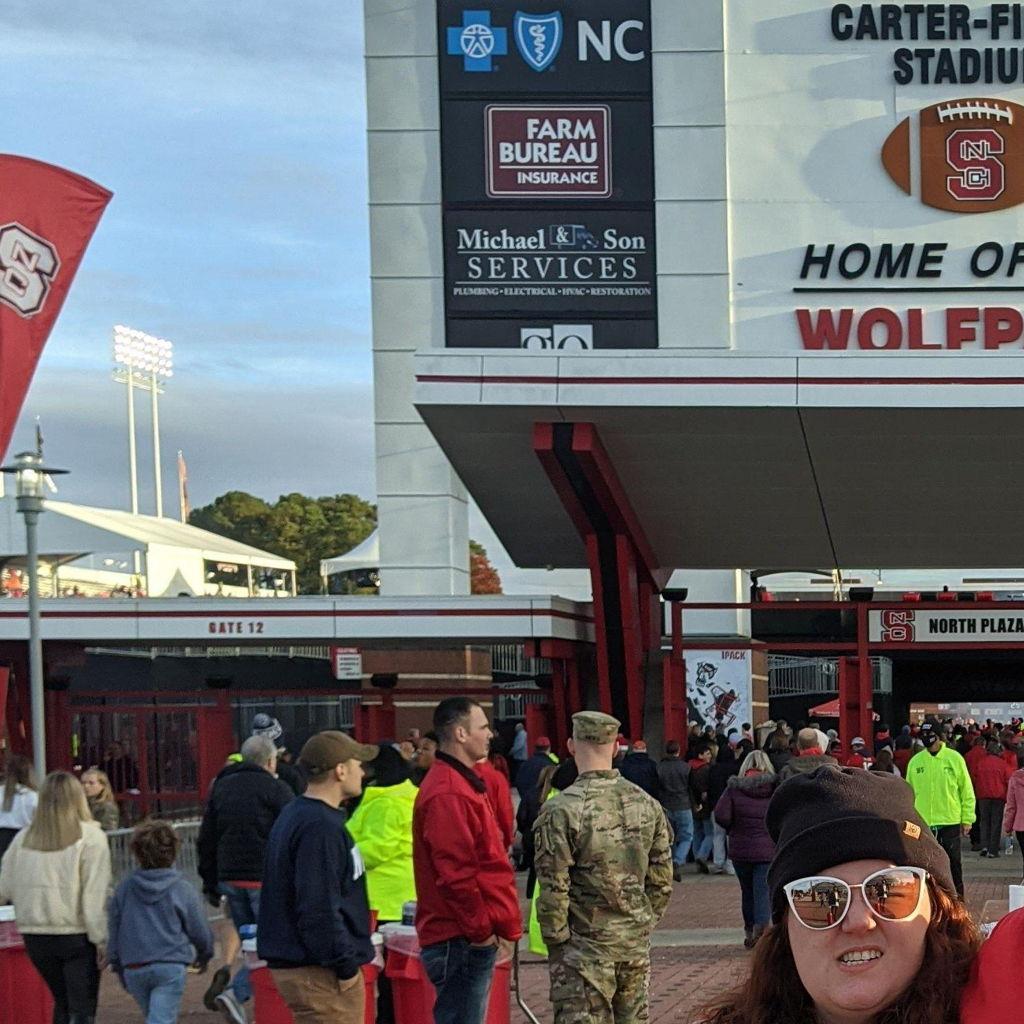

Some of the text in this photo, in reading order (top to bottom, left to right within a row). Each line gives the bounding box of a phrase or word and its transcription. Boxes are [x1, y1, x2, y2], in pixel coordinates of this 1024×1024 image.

[577, 20, 645, 61] NC
[527, 118, 596, 140] FARM
[500, 142, 597, 164] BUREAU
[517, 171, 598, 185] INSURANCE
[457, 226, 646, 250] Michael & Son
[468, 257, 637, 279] SERVICES
[799, 242, 948, 280] HOME
[453, 287, 652, 296] PLUMBING ELECTRICAL HVAC RESTORATION
[208, 622, 264, 634] GATE 12
[929, 618, 1024, 634] NORTH PLAZA
